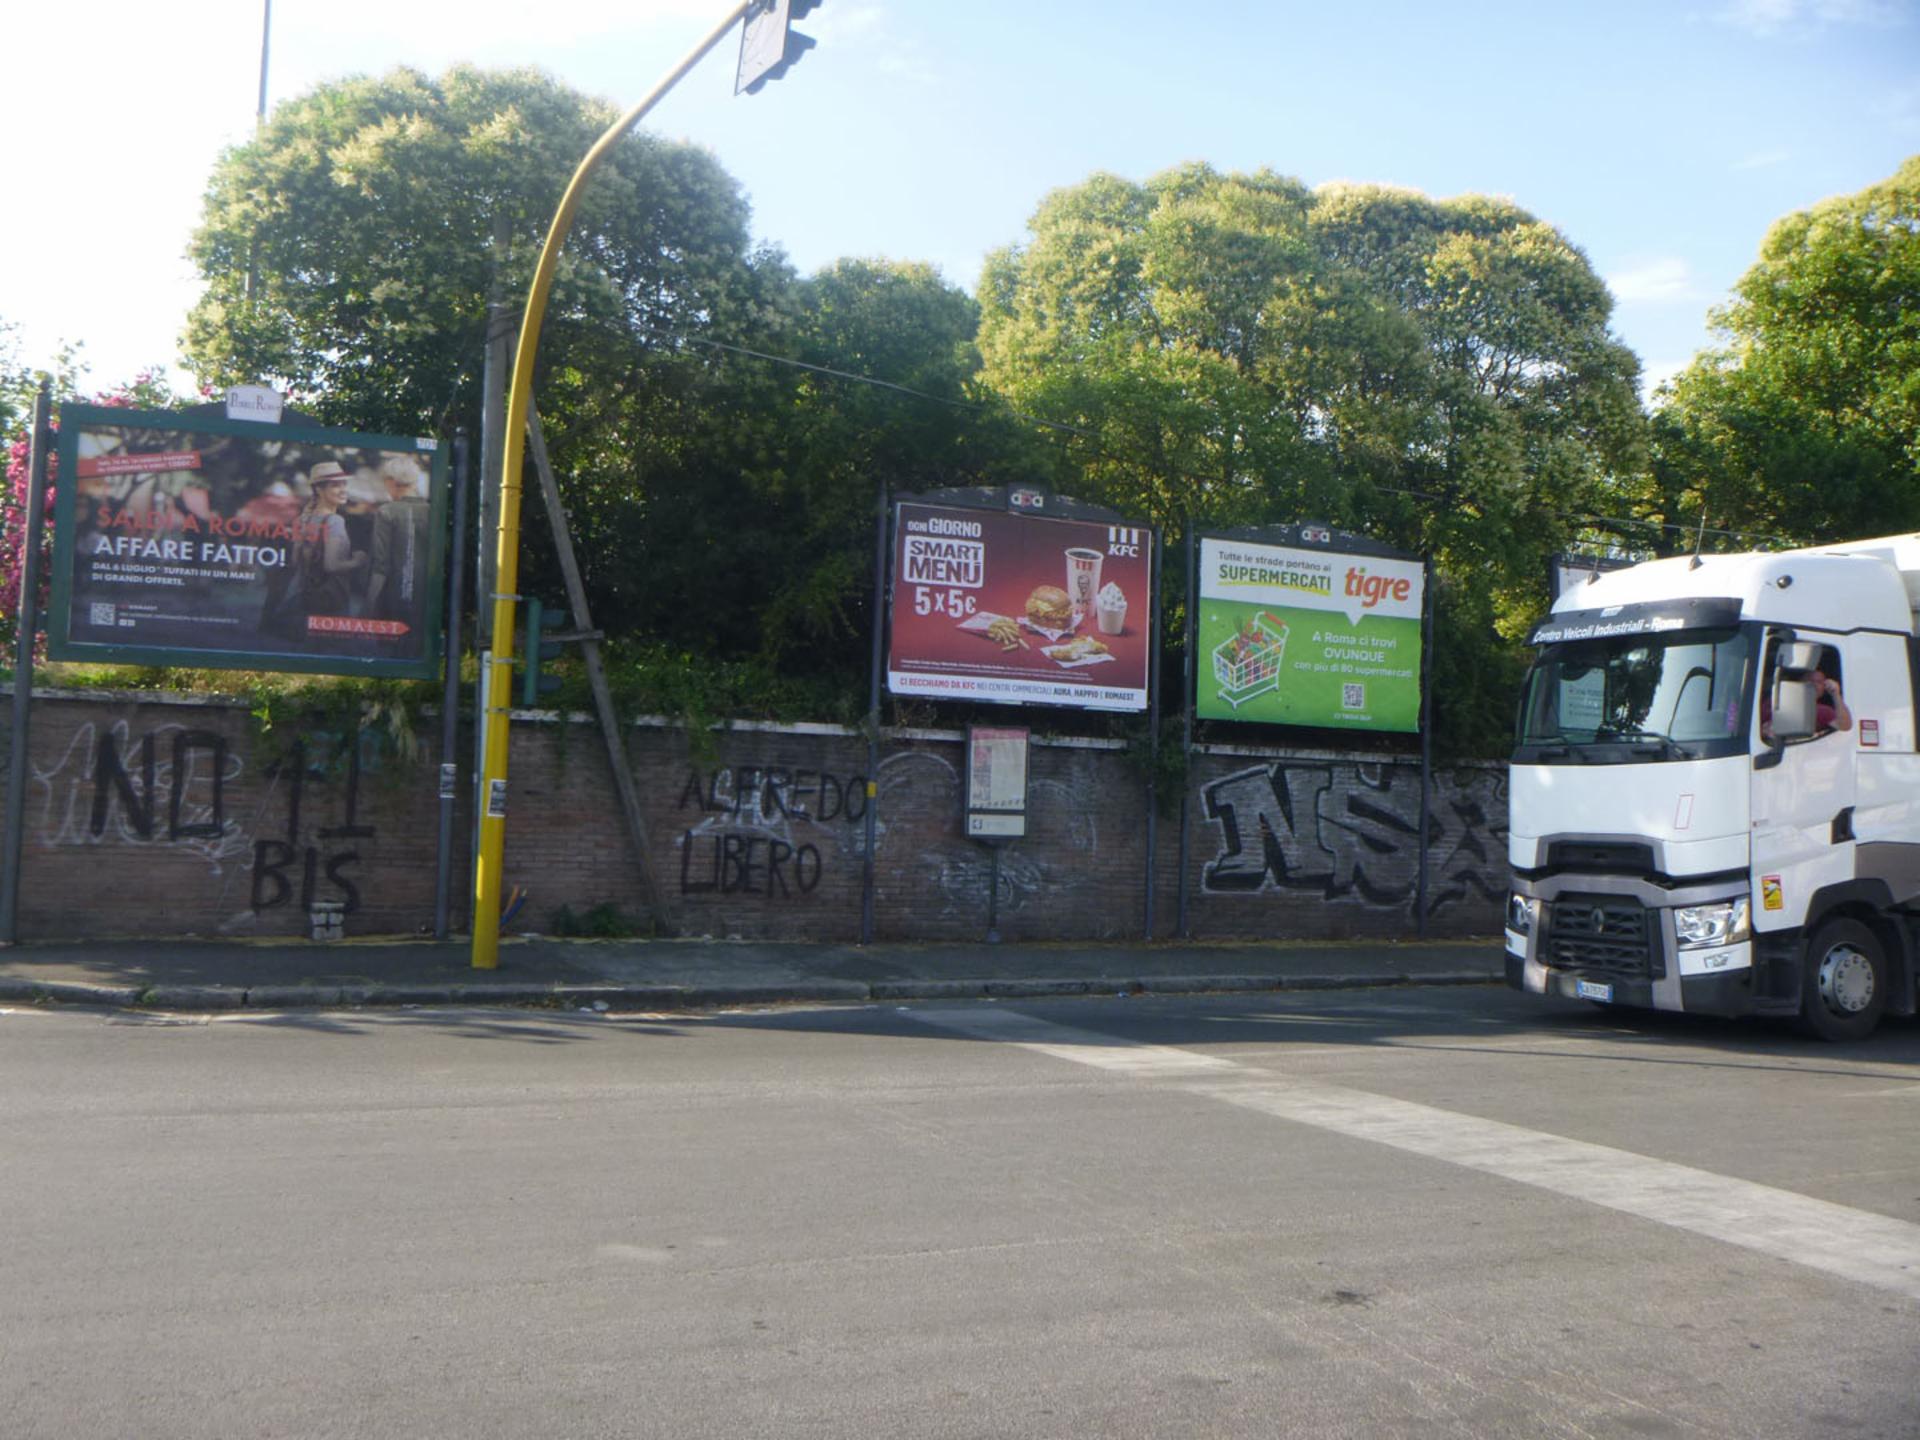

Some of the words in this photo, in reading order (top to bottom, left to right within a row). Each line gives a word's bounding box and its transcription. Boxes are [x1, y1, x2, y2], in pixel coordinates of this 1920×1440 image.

[96, 506, 174, 531] SALDI
[183, 514, 200, 533] A
[208, 512, 331, 542] ROMAEST
[907, 521, 928, 532] OGNI
[928, 517, 982, 538] GIORNO
[95, 535, 193, 561] AFFARE
[202, 542, 287, 568] FATTO!
[909, 540, 982, 561] SMART
[1108, 544, 1139, 558] KFC
[92, 562, 112, 571] DAL
[163, 566, 199, 577] TUFFATI
[200, 568, 211, 577] IN
[213, 570, 228, 579] UN
[229, 571, 256, 580] MARE
[1218, 551, 1242, 561] Tutte
[1244, 554, 1253, 562] le
[1255, 556, 1284, 567] strade
[1286, 560, 1321, 572] portano
[1323, 564, 1332, 573] ai
[92, 572, 102, 581] DI
[104, 573, 143, 583] GRANDI
[1218, 564, 1332, 591] SUPERMERCATI
[1345, 567, 1411, 609] tigre
[1312, 631, 1322, 642] A
[1325, 632, 1357, 645] Roma
[1359, 635, 1368, 646] ci
[1371, 637, 1397, 649] trovi
[1533, 630, 1562, 644] Centro
[1563, 625, 1594, 640] Veicoli
[1594, 618, 1643, 637] Industriali
[1650, 616, 1685, 632] Roma
[1324, 647, 1385, 663] OVUNQUE
[1330, 663, 1339, 673] di
[962, 681, 976, 690] KFC
[678, 767, 869, 824] ALFREDO
[681, 829, 822, 899] LIBERO
[251, 839, 362, 916] BIS
